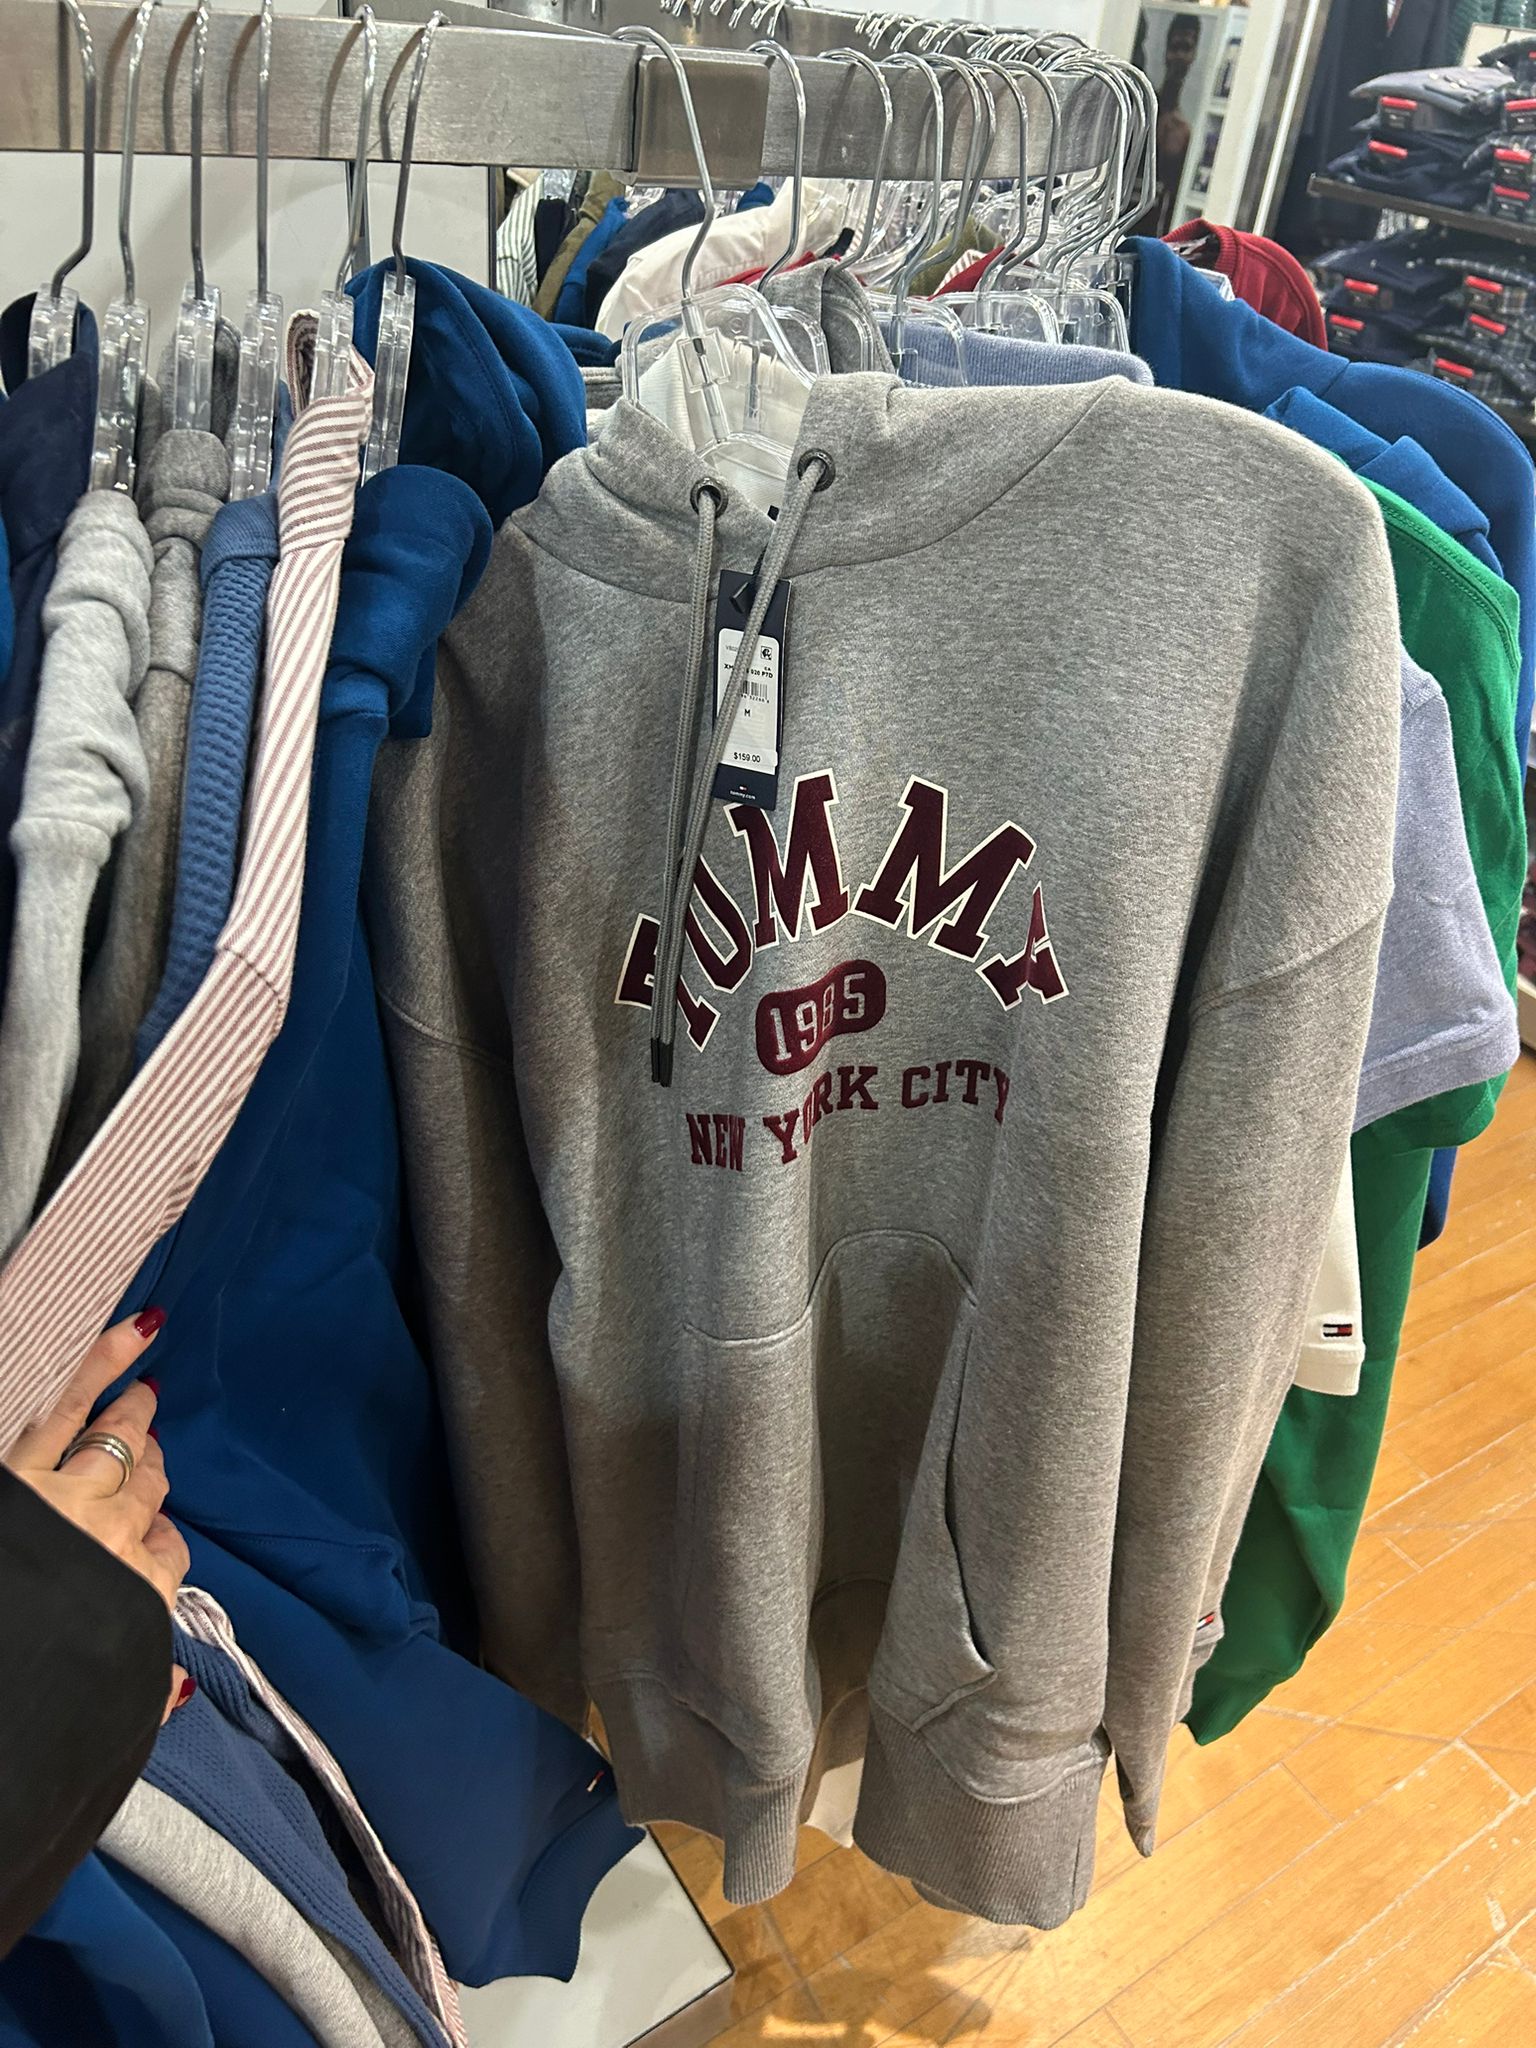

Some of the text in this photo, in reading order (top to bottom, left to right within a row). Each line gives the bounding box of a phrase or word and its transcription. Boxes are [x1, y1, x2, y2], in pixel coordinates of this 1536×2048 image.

[744, 708, 751, 717] M
[733, 751, 761, 763] $159.00
[729, 789, 756, 801] tommy.com
[769, 972, 866, 1062] 1985
[685, 1113, 746, 1172] NEW
